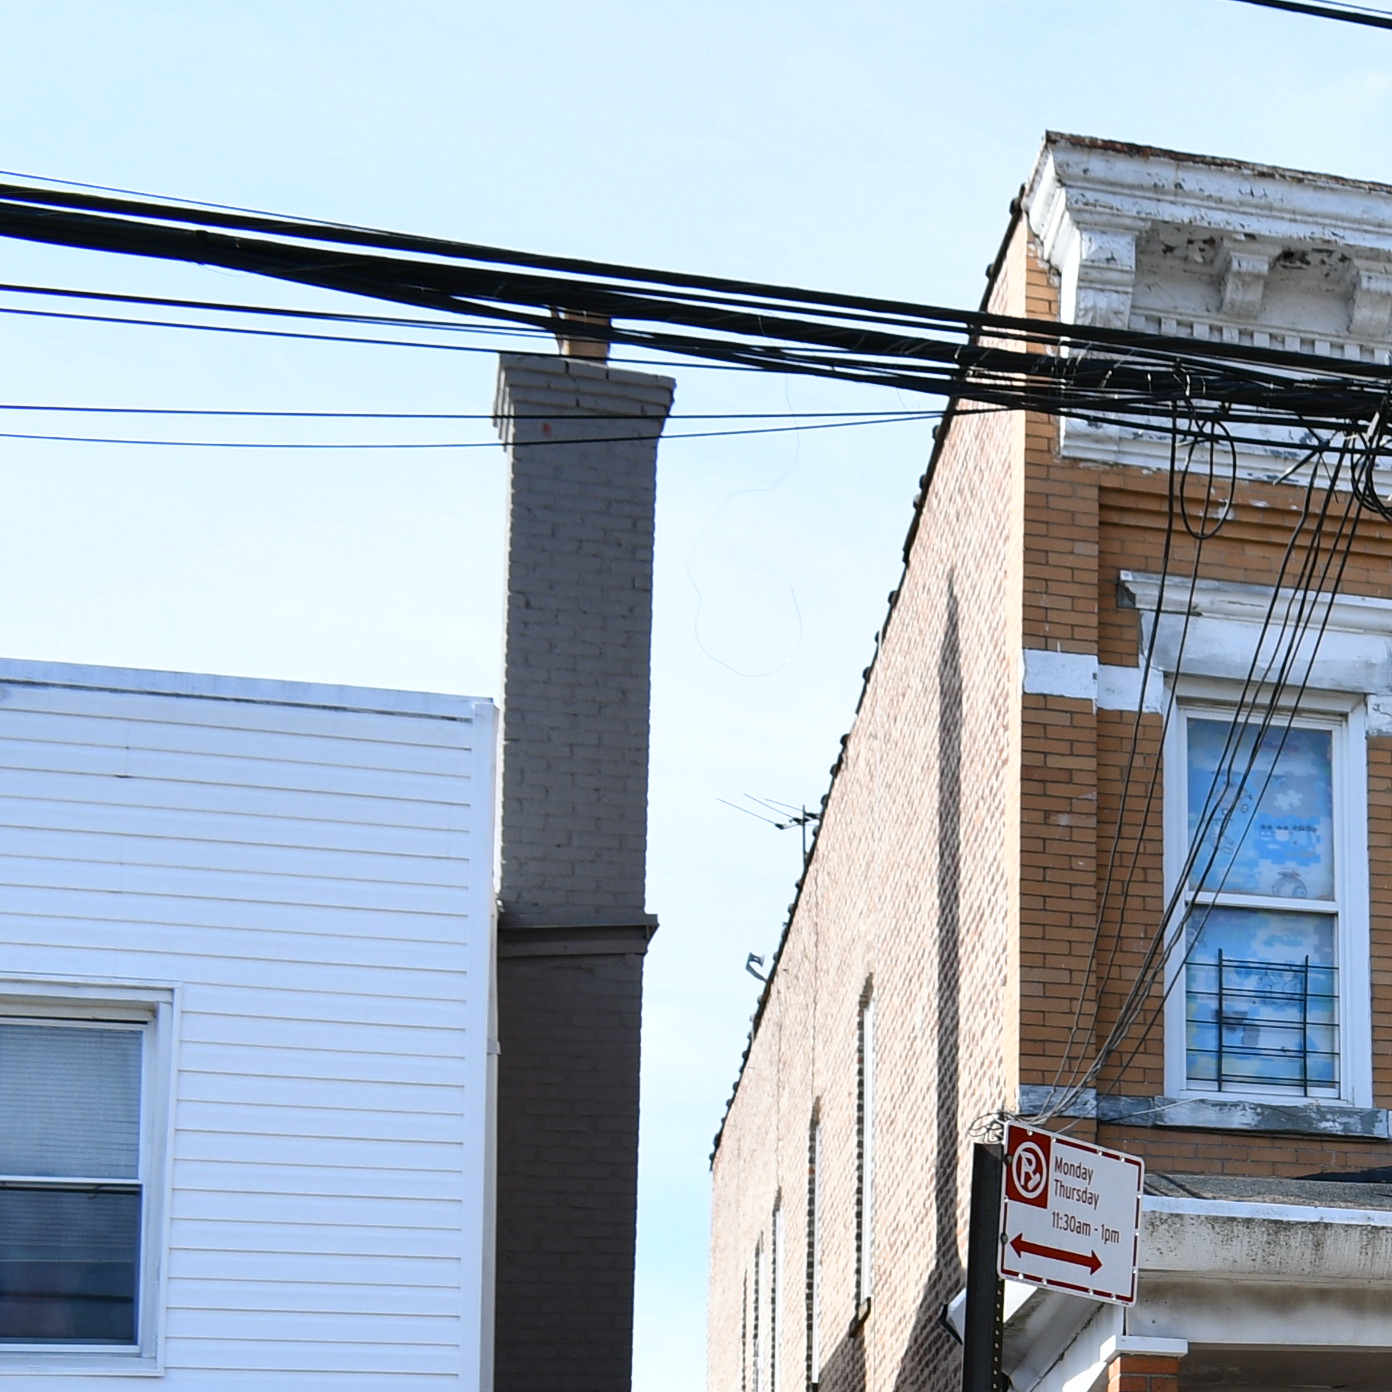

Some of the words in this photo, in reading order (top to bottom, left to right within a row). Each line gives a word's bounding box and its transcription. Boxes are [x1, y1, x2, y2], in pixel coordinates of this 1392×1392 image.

[1054, 1155, 1094, 1186] Monday
[1054, 1178, 1100, 1211] Thursday
[1052, 1211, 1091, 1237] 11:30am
[1101, 1223, 1120, 1245] 1pm
